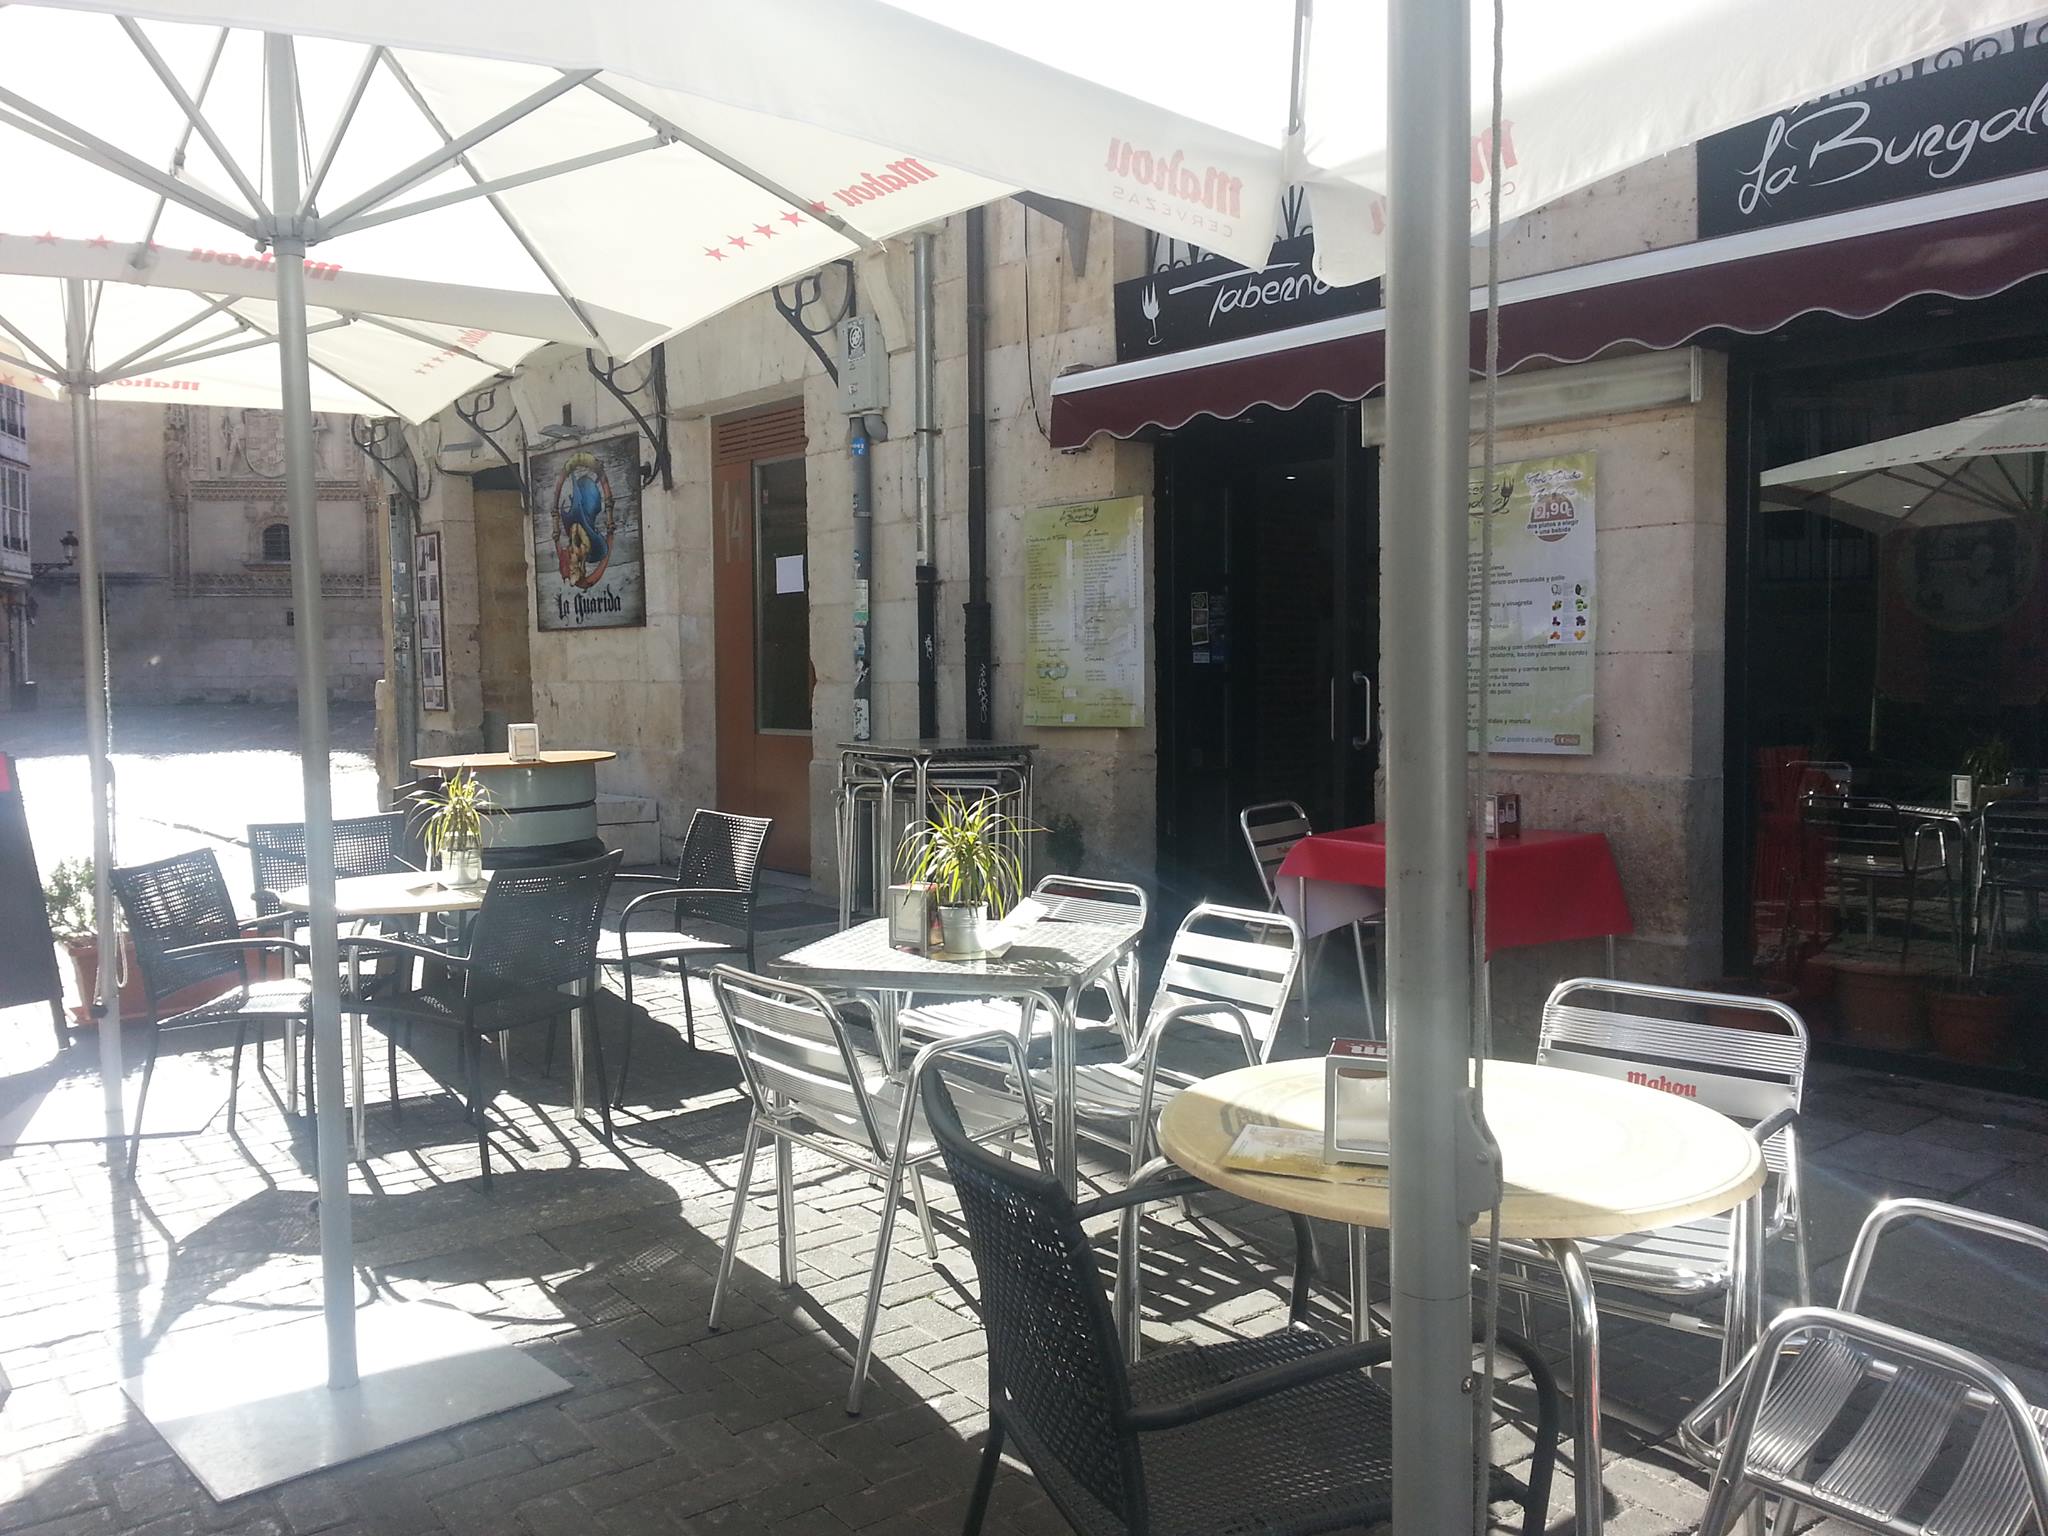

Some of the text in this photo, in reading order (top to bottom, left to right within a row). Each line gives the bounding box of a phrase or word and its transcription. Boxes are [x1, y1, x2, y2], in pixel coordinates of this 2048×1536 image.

[1736, 80, 2048, 214] La Burgal
[1627, 1071, 1697, 1098] Mahou
